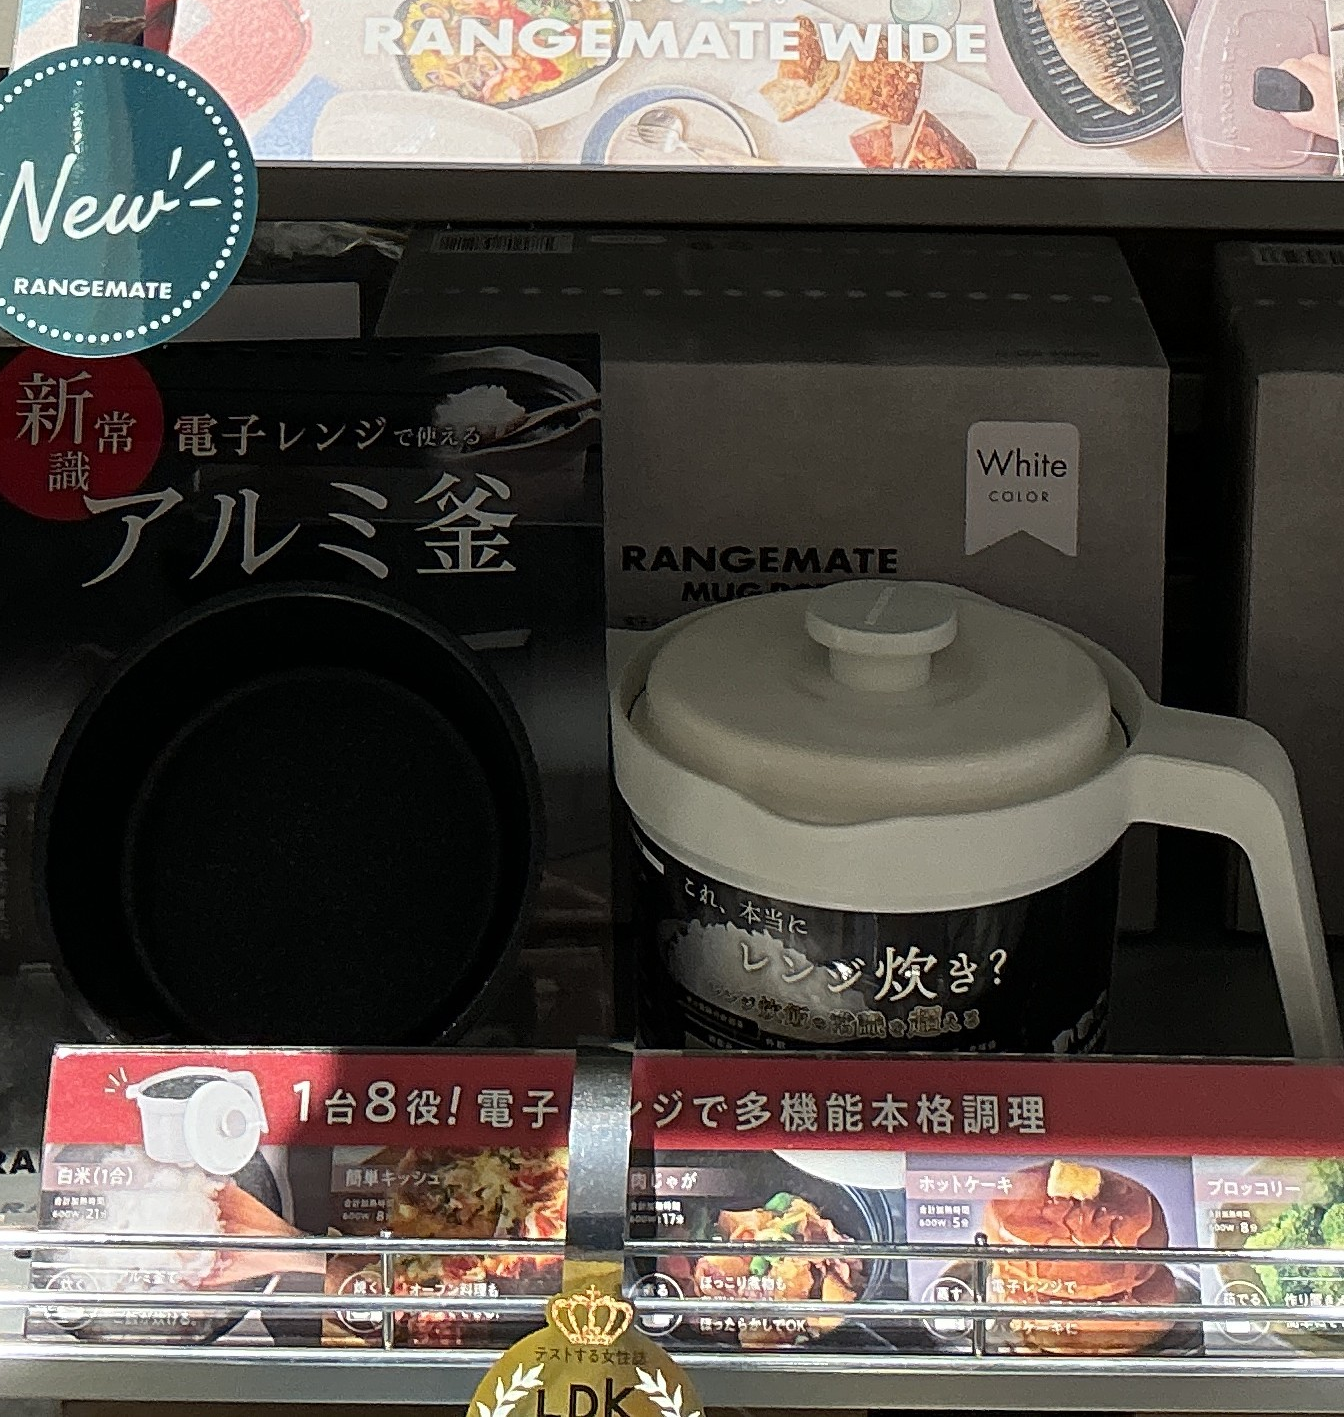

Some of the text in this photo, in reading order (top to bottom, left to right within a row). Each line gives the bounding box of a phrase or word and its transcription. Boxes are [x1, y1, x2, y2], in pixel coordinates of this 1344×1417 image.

[362, 17, 988, 63] RANGEMATE WIDE
[13, 277, 173, 300] RANGEMATE
[173, 413, 482, 458] 電子レンジで使える
[976, 448, 1068, 479] White
[988, 490, 1051, 503] COLOR
[81, 471, 519, 589] アルミ釜
[621, 545, 898, 575] RANGEMATE
[683, 878, 809, 936] これ、本当に
[344, 1169, 441, 1188] 簡単キッシュ
[629, 1170, 698, 1191] 肉じゃが
[918, 1175, 1013, 1195] ホットケーキ
[1206, 1177, 1301, 1198] ブロッコリー
